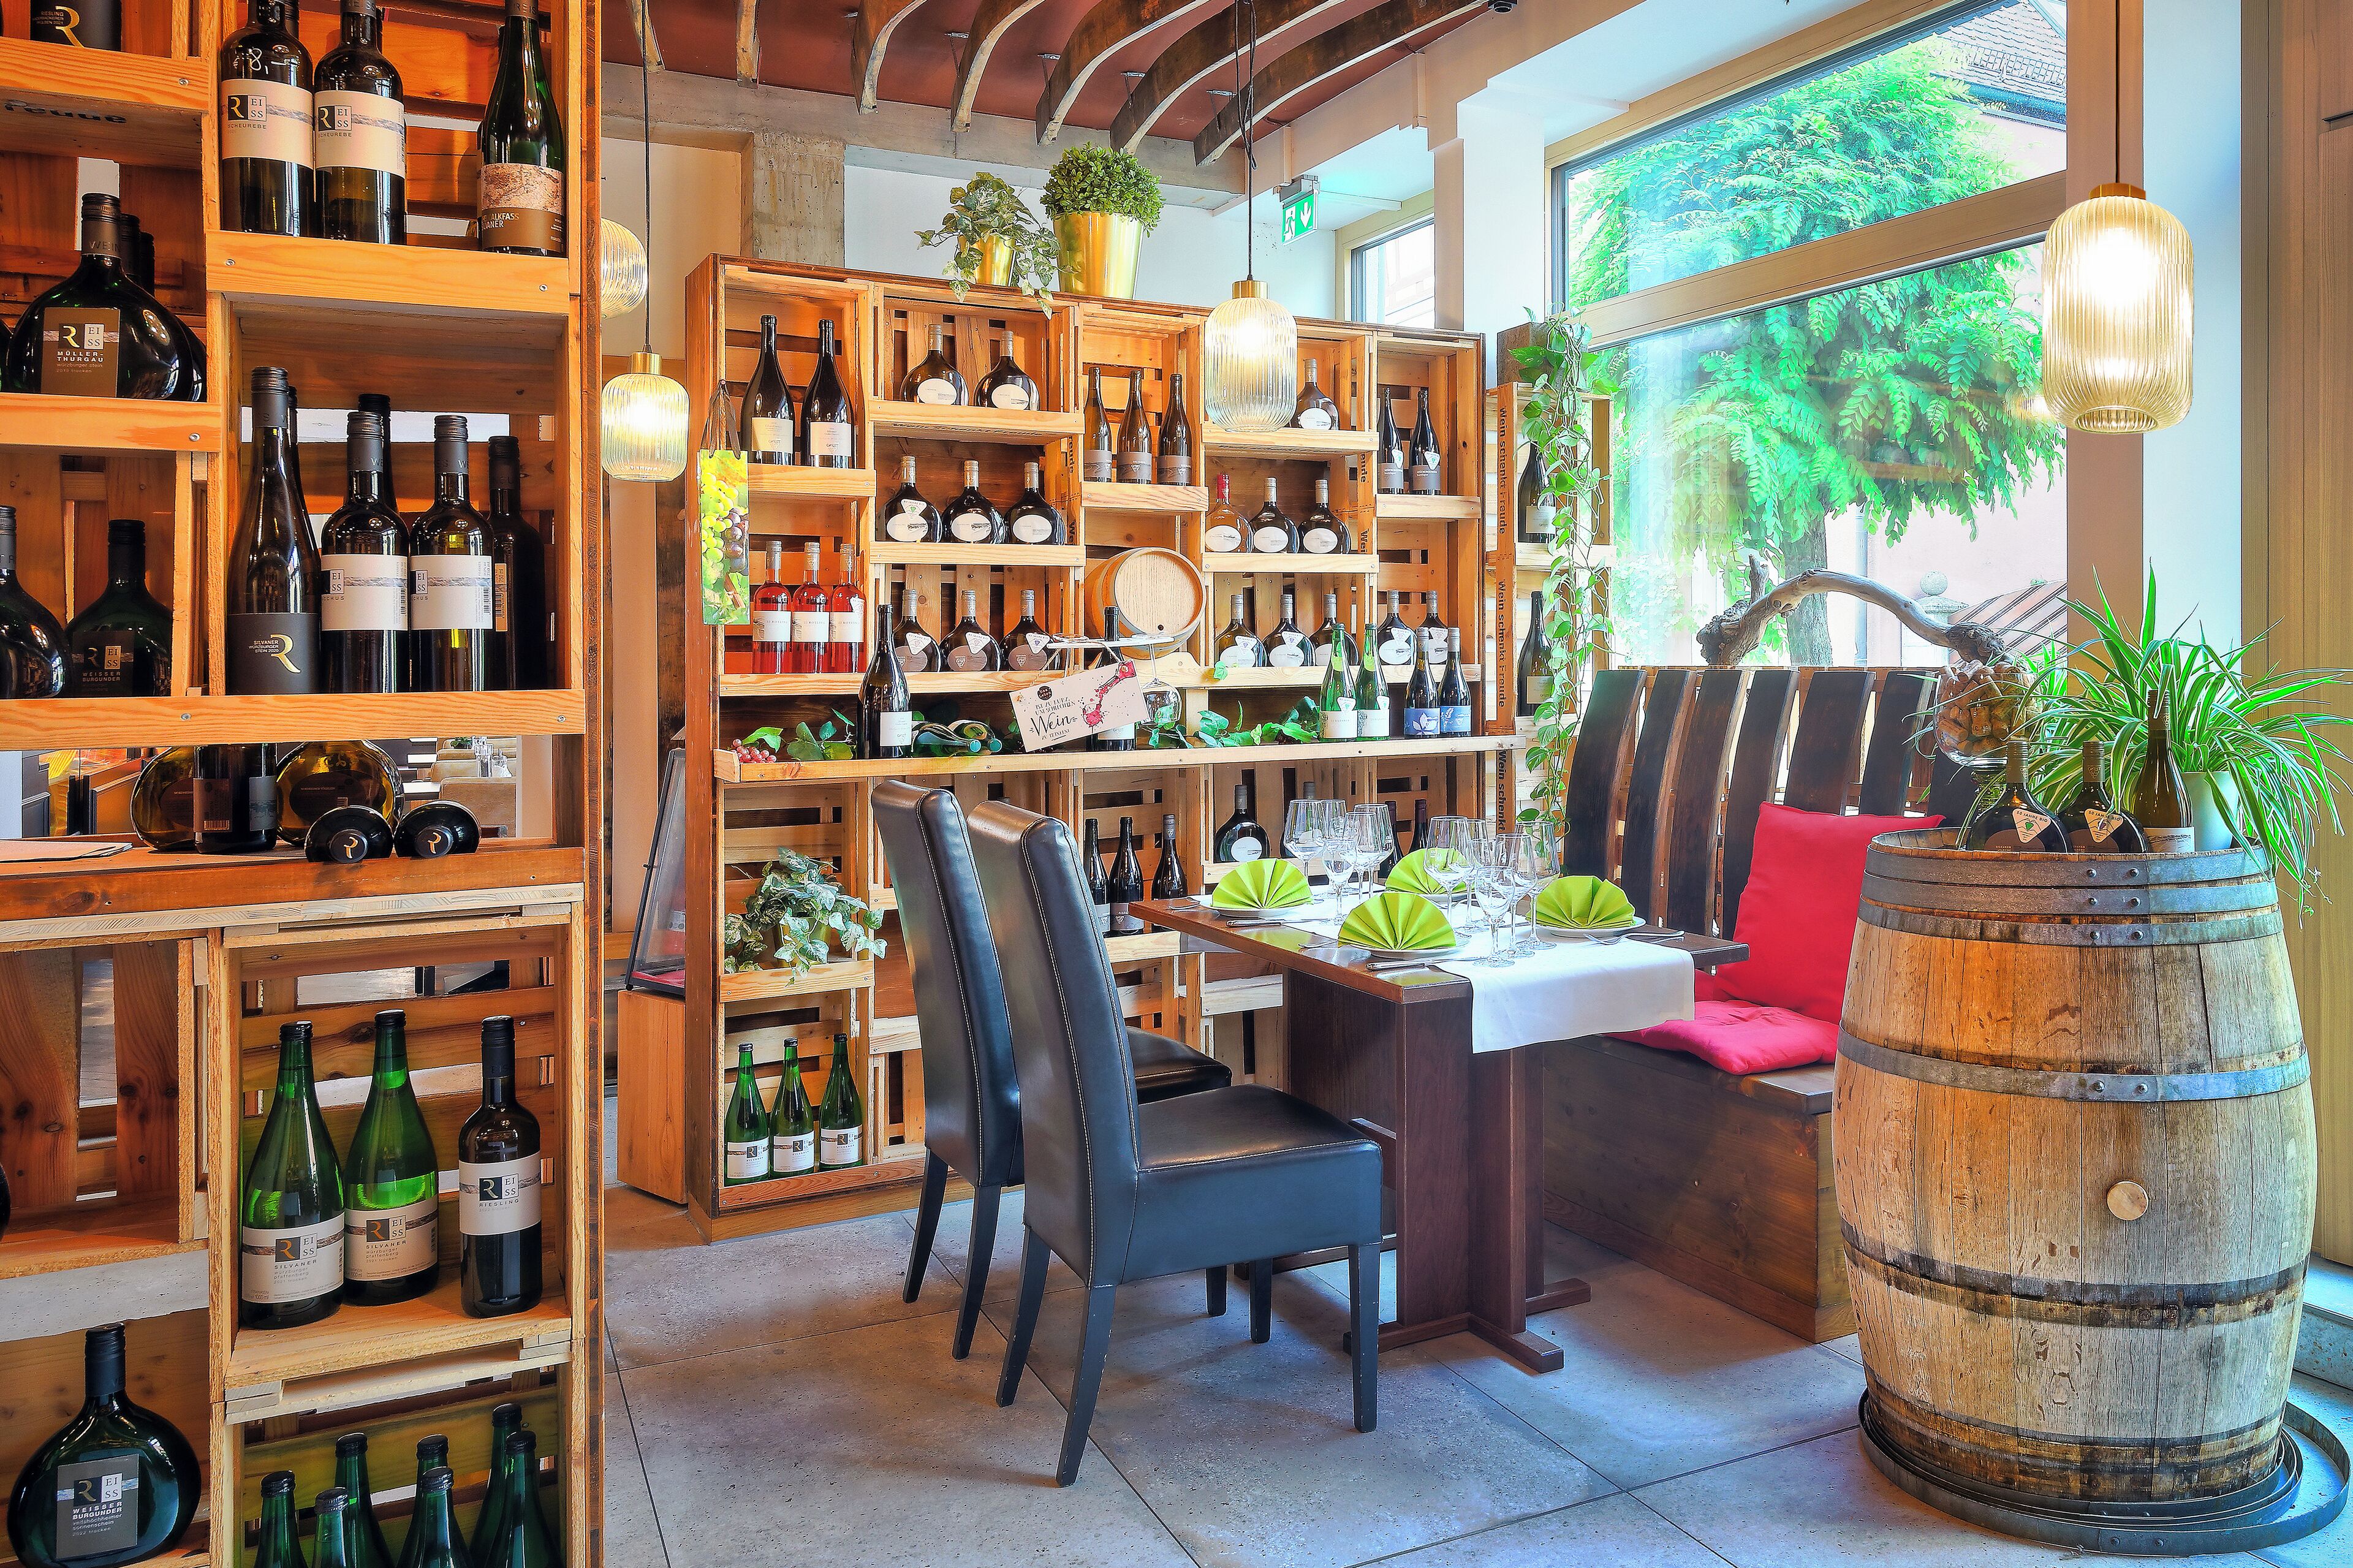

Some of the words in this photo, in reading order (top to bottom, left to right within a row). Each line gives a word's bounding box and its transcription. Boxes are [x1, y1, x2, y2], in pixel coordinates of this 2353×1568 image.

[230, 97, 244, 118] R
[320, 107, 332, 128] R
[63, 325, 80, 348] R
[1499, 441, 1508, 489] schenkt
[417, 583, 425, 592] SS
[1498, 579, 1507, 610] Wein
[1498, 615, 1507, 661] schenkt
[88, 647, 100, 668] R
[270, 634, 301, 673] R
[1498, 665, 1507, 707] Freude
[1031, 712, 1073, 737] Wein
[1498, 749, 1507, 779] Wein
[483, 1178, 499, 1199] R
[505, 1187, 517, 1196] SS
[370, 1221, 385, 1240] R
[392, 1218, 403, 1227] EI
[280, 1240, 295, 1259] R
[303, 1237, 314, 1246] EI
[366, 1240, 407, 1250] SILVANER
[303, 1248, 314, 1257] SS
[275, 1259, 317, 1270] SILVANER
[78, 1480, 97, 1502] R
[106, 1477, 118, 1487] EI
[105, 1489, 119, 1499] SS
[72, 1507, 123, 1520] BURGUNDER
[73, 1501, 123, 1515] WEISSER
[72, 1520, 115, 1531] sonnenschein
